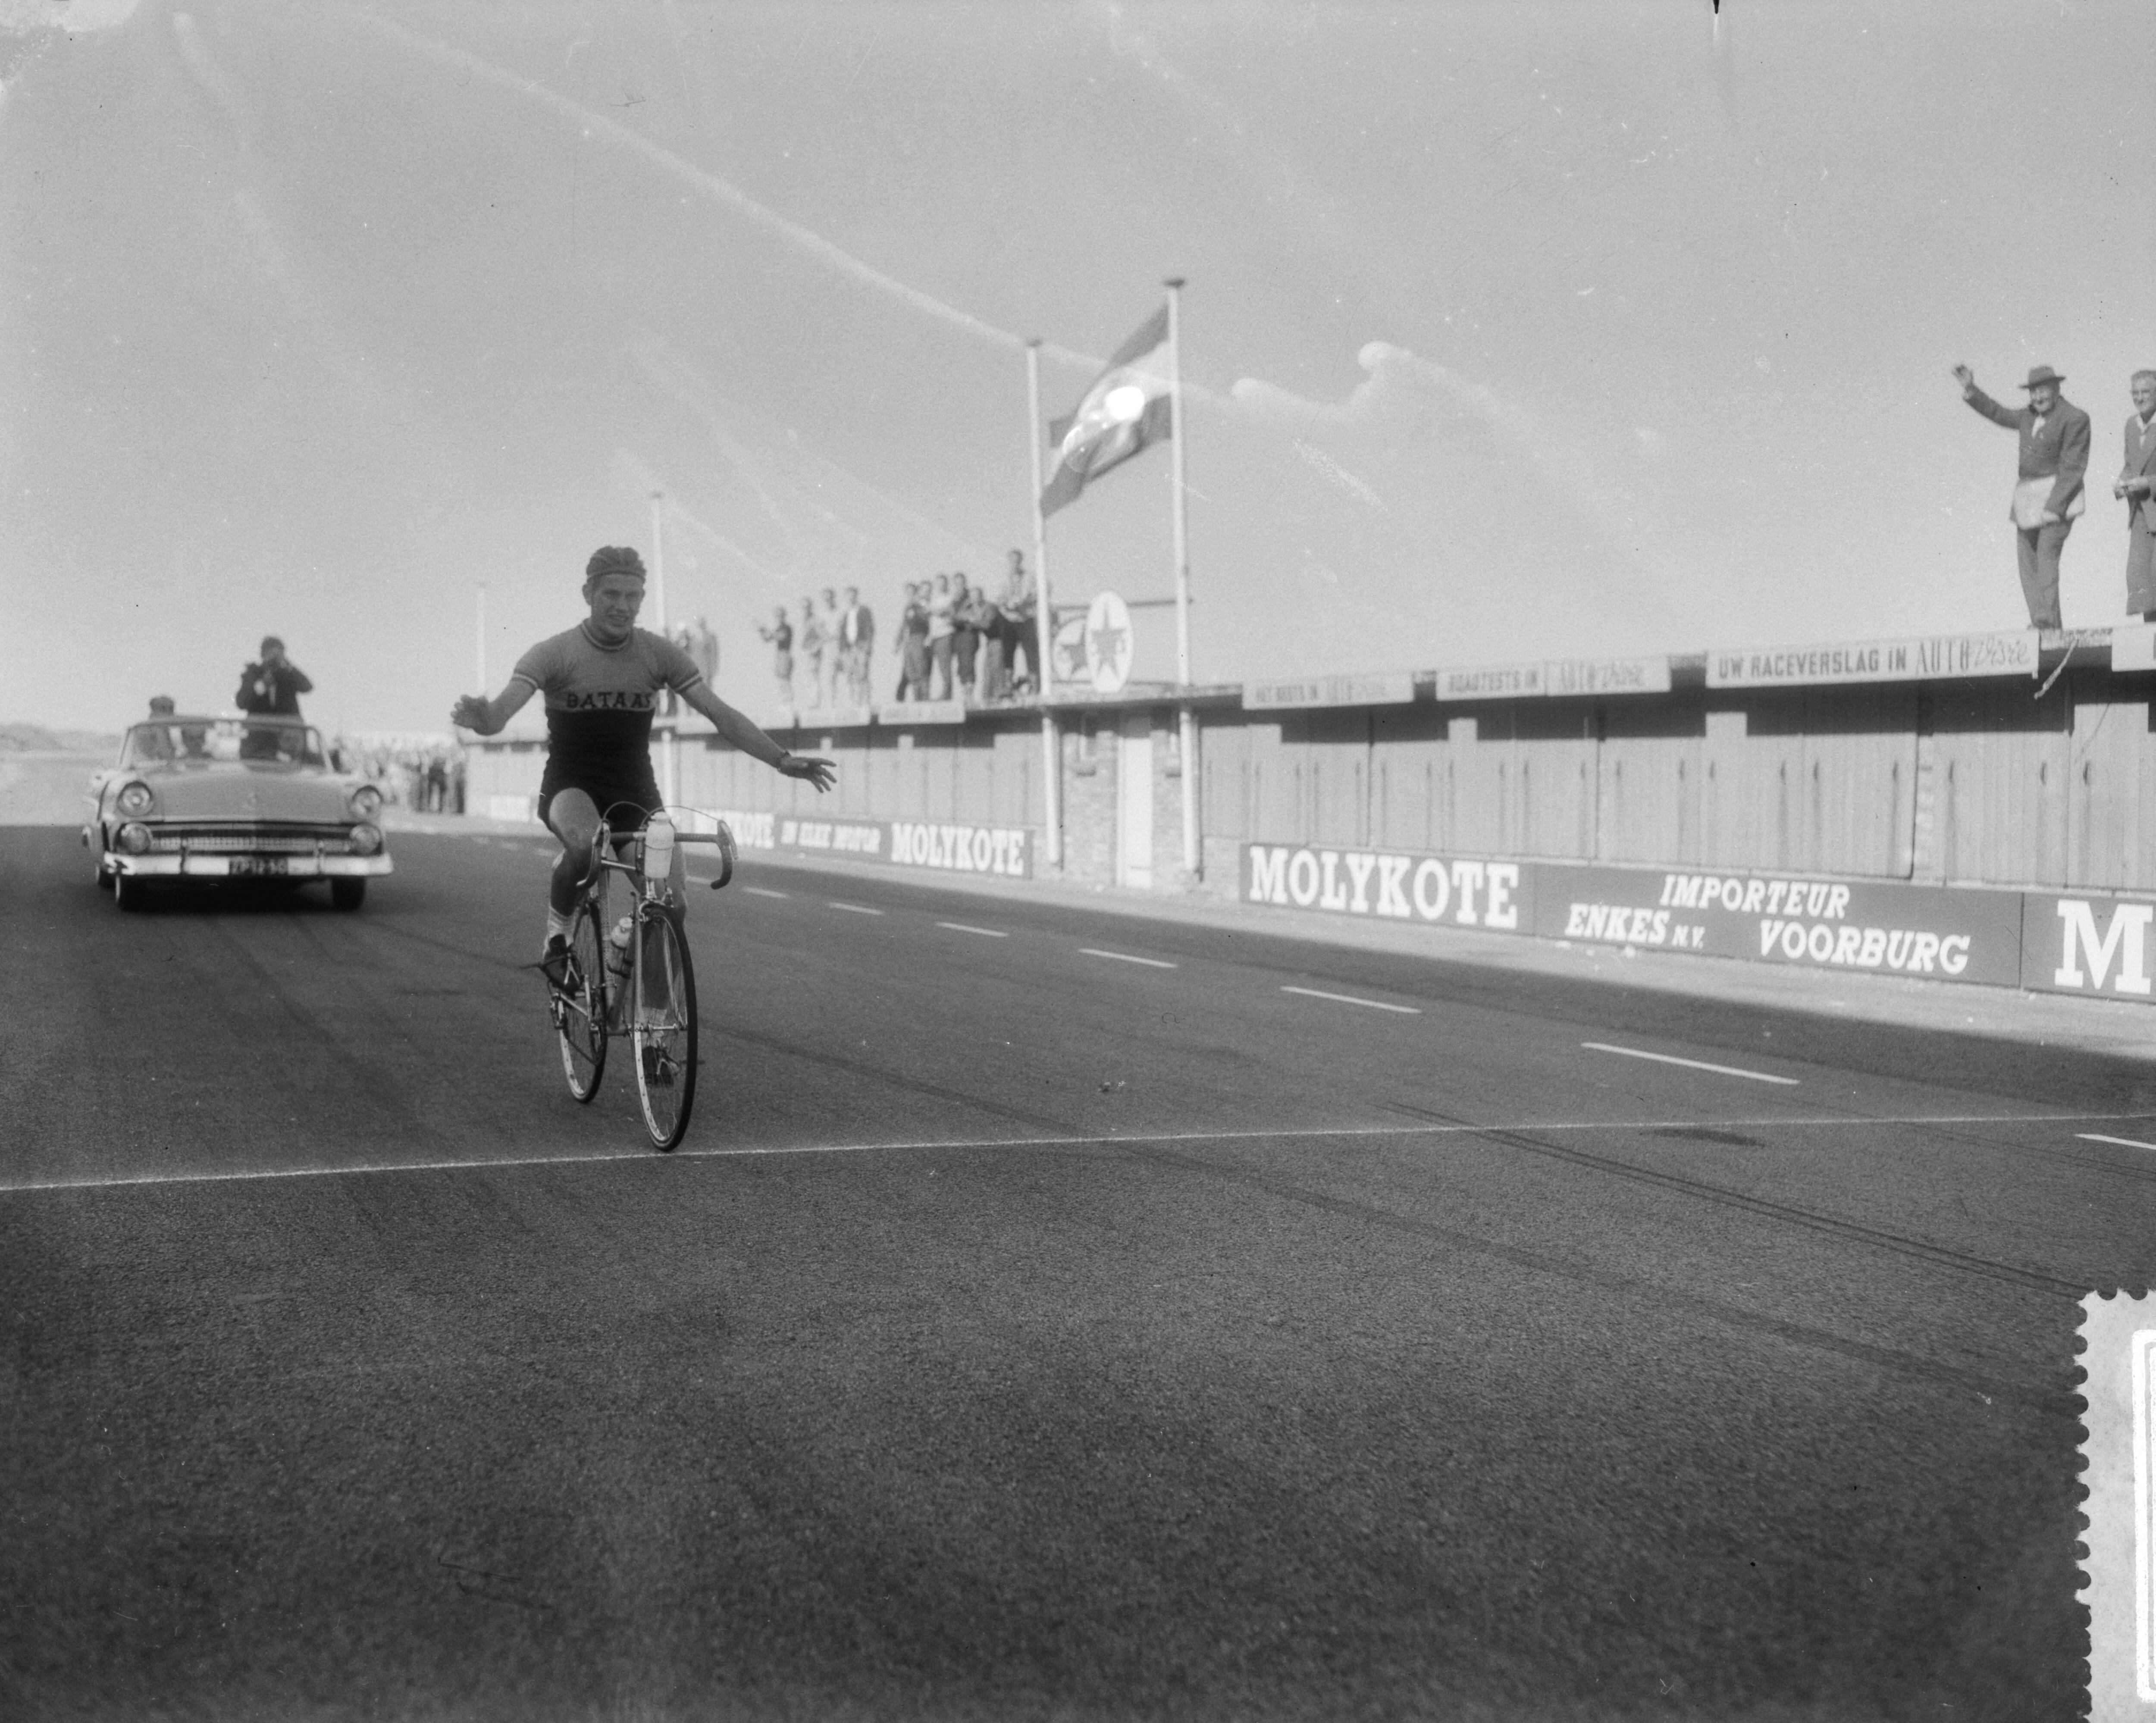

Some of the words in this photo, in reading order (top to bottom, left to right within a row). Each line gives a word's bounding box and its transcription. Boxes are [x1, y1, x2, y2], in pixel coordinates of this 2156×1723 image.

[1718, 656, 1745, 680] UW
[1751, 649, 1879, 678] RACEVERSLAG
[891, 823, 1025, 876] MOLYKOTE
[1250, 846, 1519, 929] MOLYKOTE
[1659, 874, 1850, 919] IMPORTEUR
[1565, 902, 1670, 946] ENKES
[1759, 919, 1971, 975] VOORBURG
[2055, 899, 2153, 995] M
